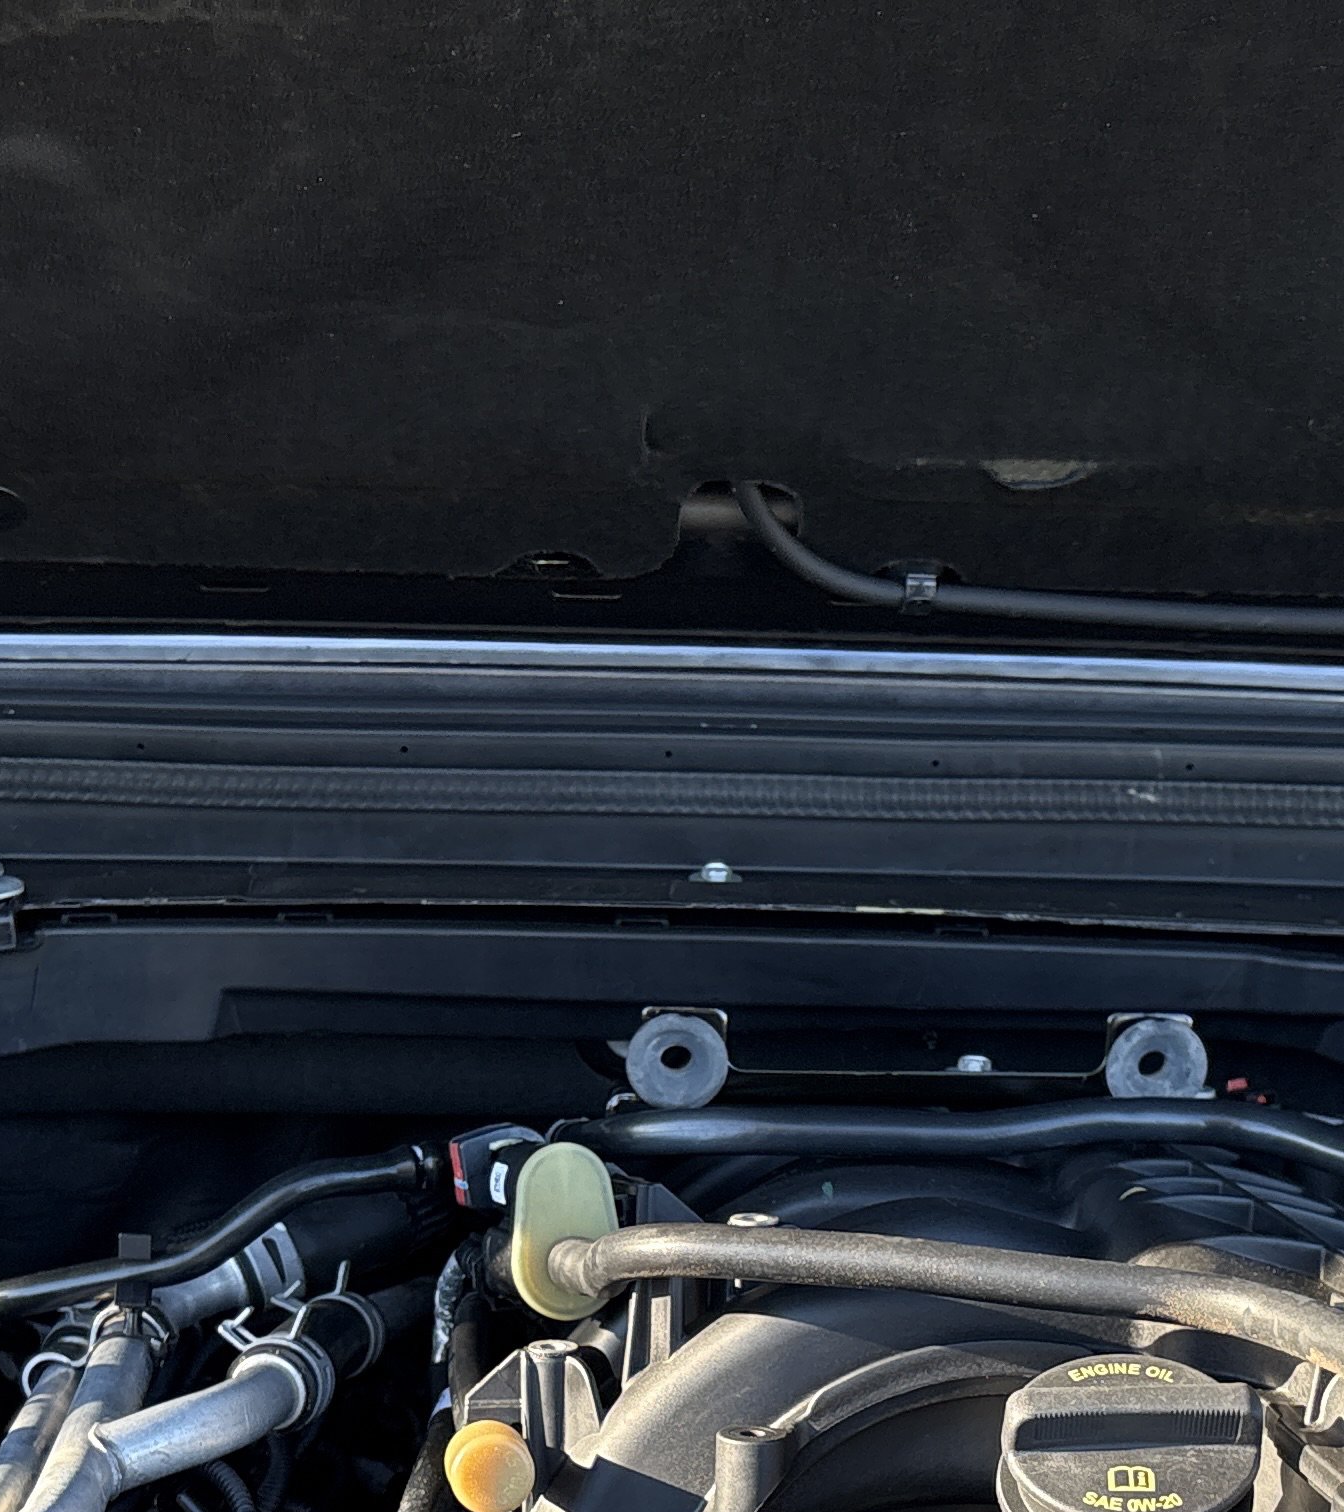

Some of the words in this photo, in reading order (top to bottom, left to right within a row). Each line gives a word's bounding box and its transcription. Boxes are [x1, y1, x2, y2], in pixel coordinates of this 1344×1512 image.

[1067, 1362, 1141, 1382] ENGINE
[1145, 1365, 1175, 1384] OIL
[1082, 1491, 1124, 1512] SAE
